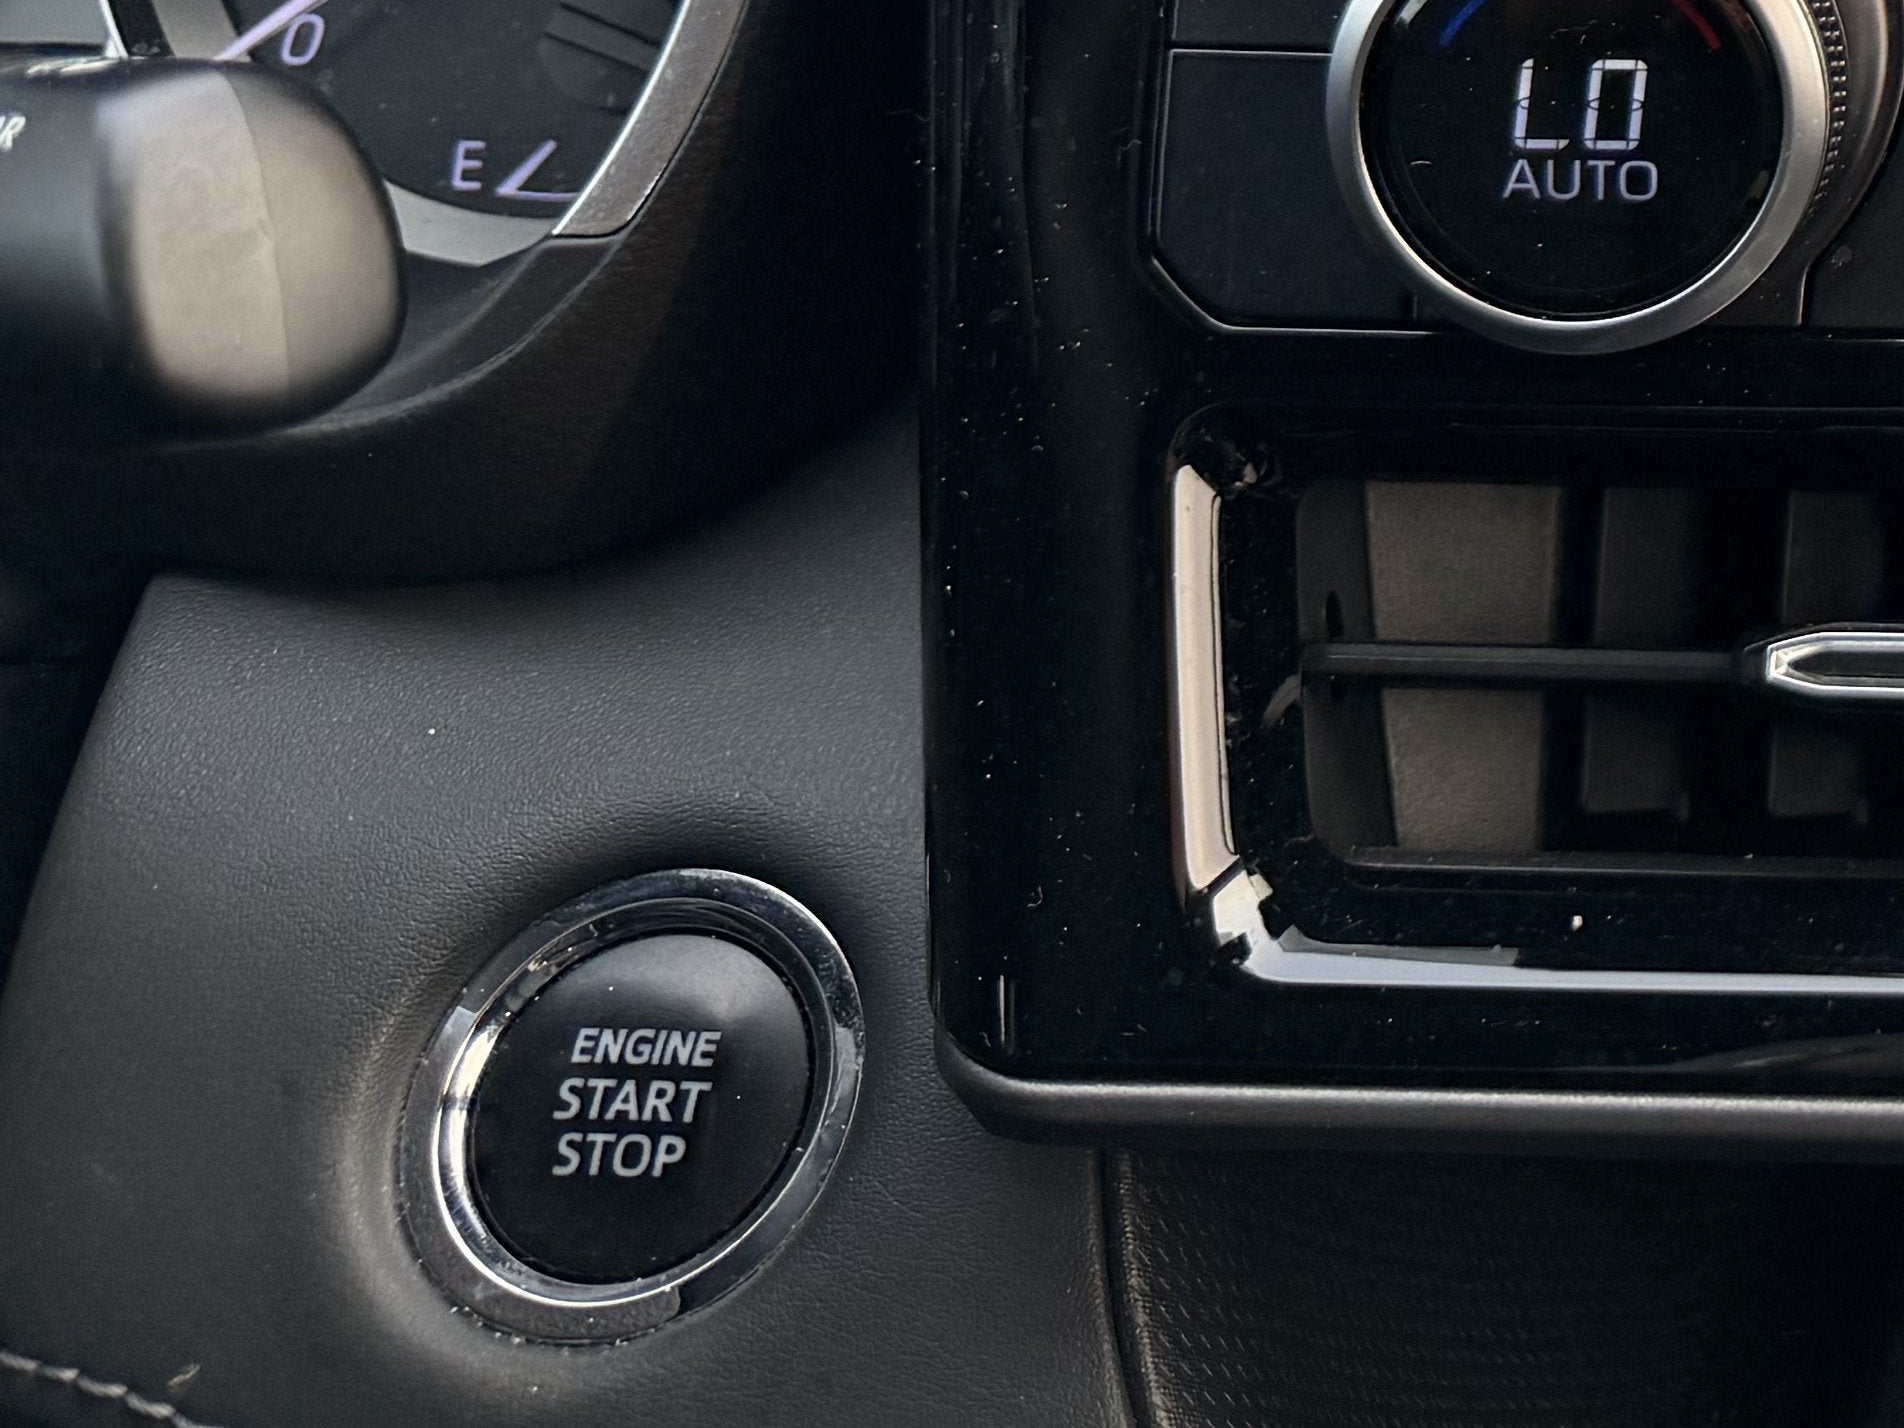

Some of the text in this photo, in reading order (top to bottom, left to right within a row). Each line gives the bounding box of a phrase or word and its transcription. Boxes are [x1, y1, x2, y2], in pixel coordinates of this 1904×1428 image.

[281, 12, 325, 66] 0
[1514, 58, 1648, 151] LO
[452, 141, 485, 192] E
[1502, 159, 1659, 202] AUTO
[570, 1028, 722, 1067] ENGINE
[552, 1078, 713, 1124] START
[551, 1133, 688, 1178] STOP
